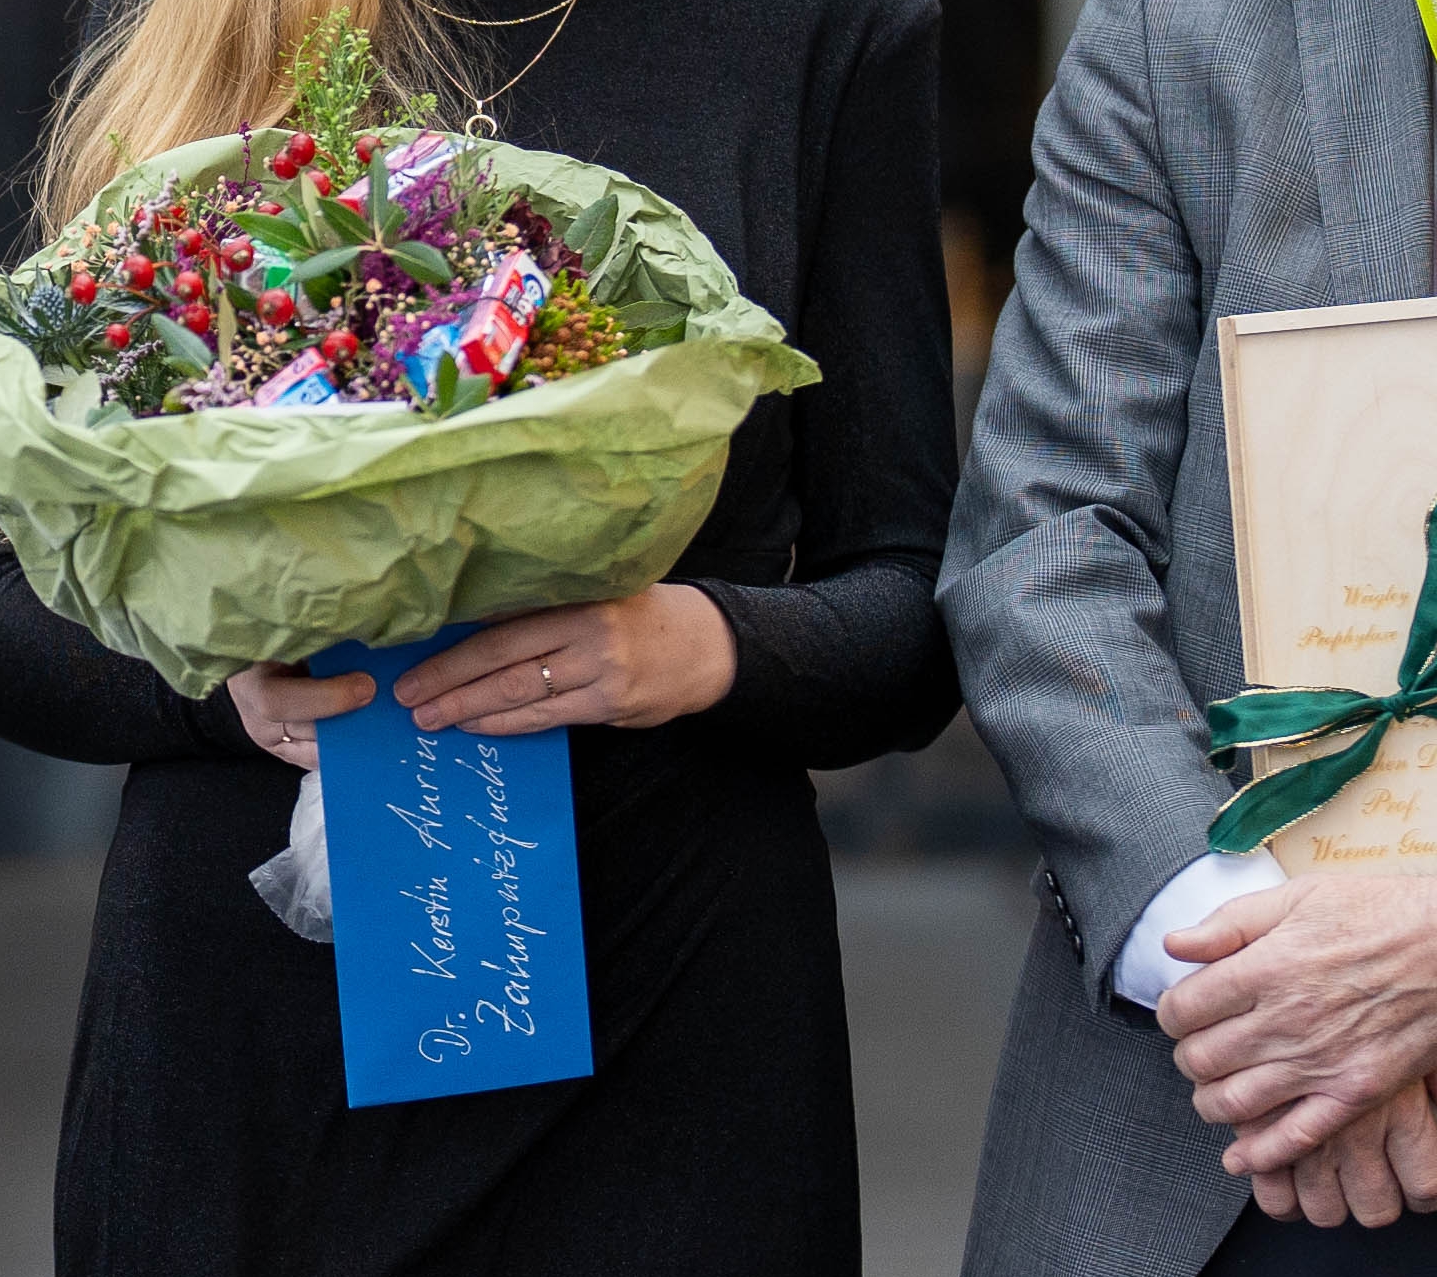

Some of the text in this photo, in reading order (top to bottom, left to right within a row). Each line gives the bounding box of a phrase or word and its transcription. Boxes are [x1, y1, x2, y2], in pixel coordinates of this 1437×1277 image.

[386, 734, 472, 1063] Dr. Kerstin Aurin
[1311, 833, 1389, 862] Werner
